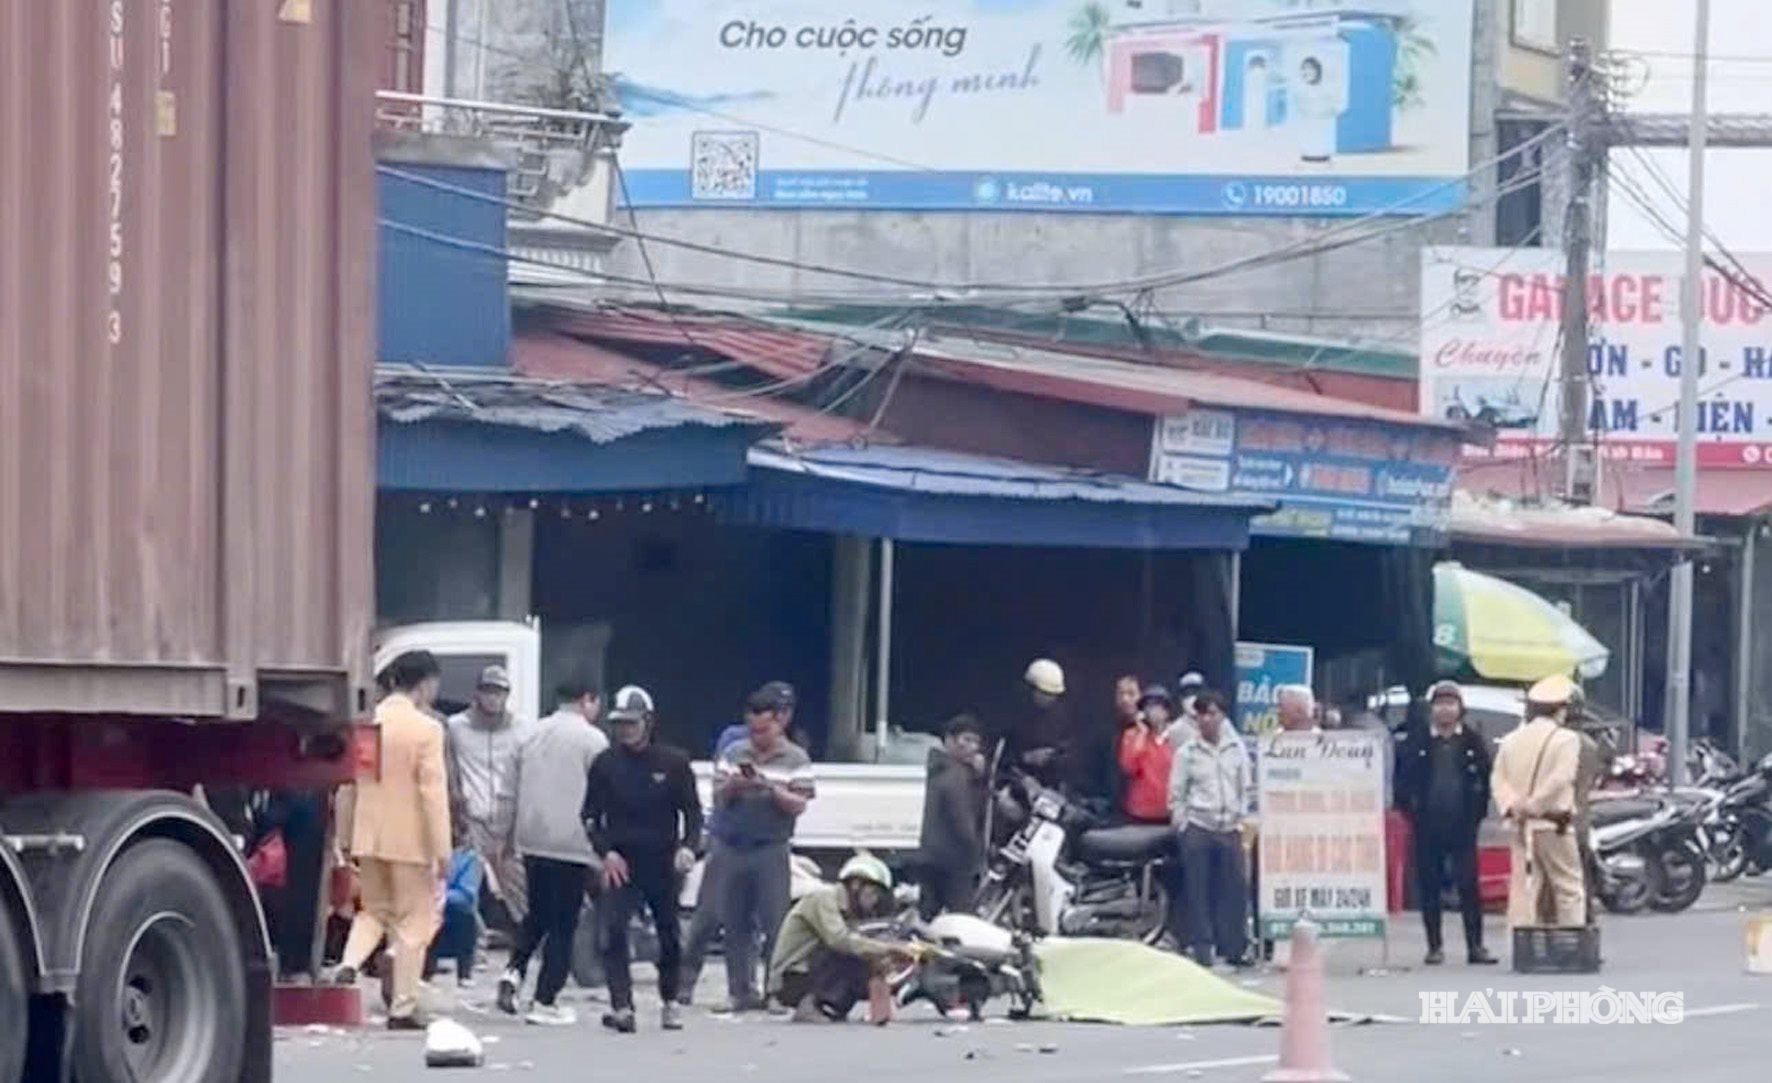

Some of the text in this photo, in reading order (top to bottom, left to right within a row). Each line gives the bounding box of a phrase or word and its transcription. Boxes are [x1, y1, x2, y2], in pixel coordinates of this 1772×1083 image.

[720, 15, 967, 57] Cho cuộc sống
[951, 43, 1041, 93] minh
[110, 82, 122, 294] 482759
[109, 311, 121, 343] 3
